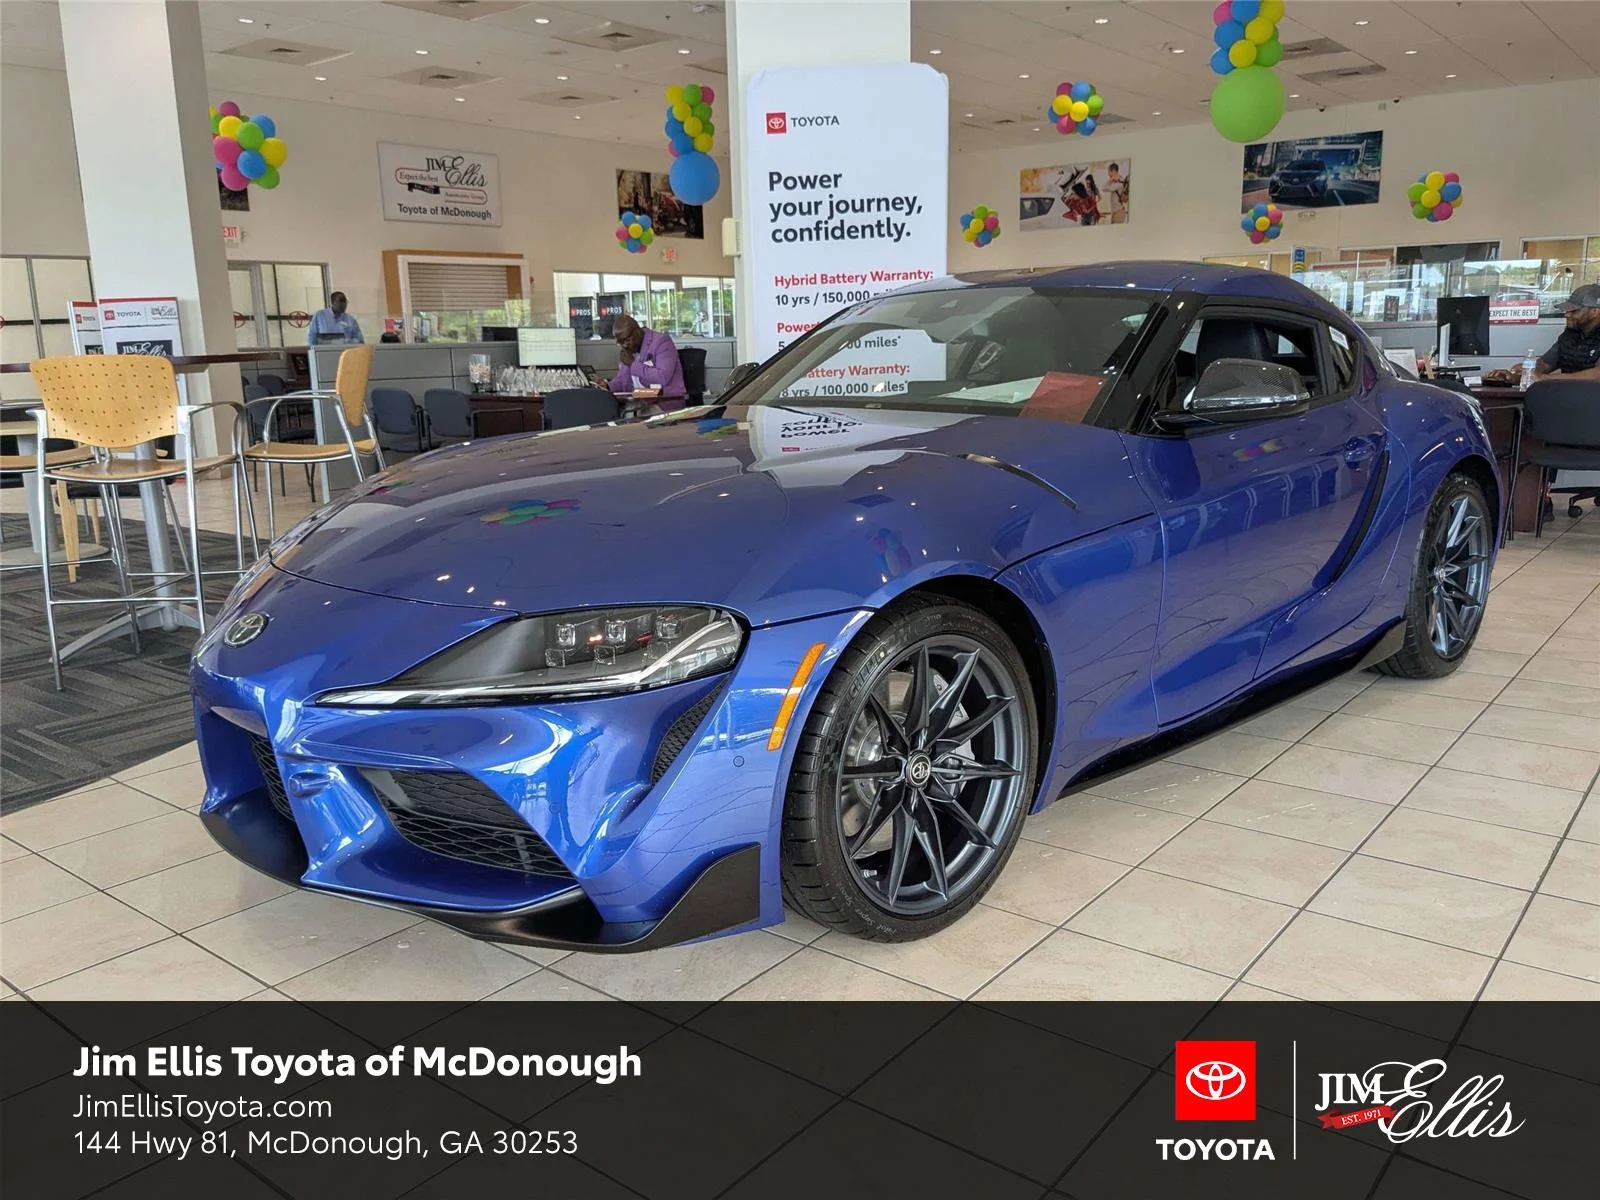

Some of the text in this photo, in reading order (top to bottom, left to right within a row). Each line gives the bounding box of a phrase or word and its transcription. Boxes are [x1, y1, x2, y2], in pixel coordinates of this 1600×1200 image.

[790, 115, 840, 128] TOYOTA
[425, 155, 488, 187] JIM Ellis
[768, 171, 843, 192] Power
[397, 203, 492, 220] Toyota of McDonough
[768, 193, 923, 223] your journey,
[771, 217, 911, 243] confidently.
[774, 269, 934, 289] Hybrid Battery Warranty:
[775, 294, 789, 306] 10
[791, 296, 811, 308] yrs
[822, 290, 870, 306] 150,000
[576, 308, 591, 316] PROS
[606, 306, 623, 315] PROS
[1489, 308, 1537, 318] EXPECT THE BEST
[807, 363, 910, 380] attery Warranty:
[791, 388, 810, 397] yrs
[821, 382, 869, 397] 100,000
